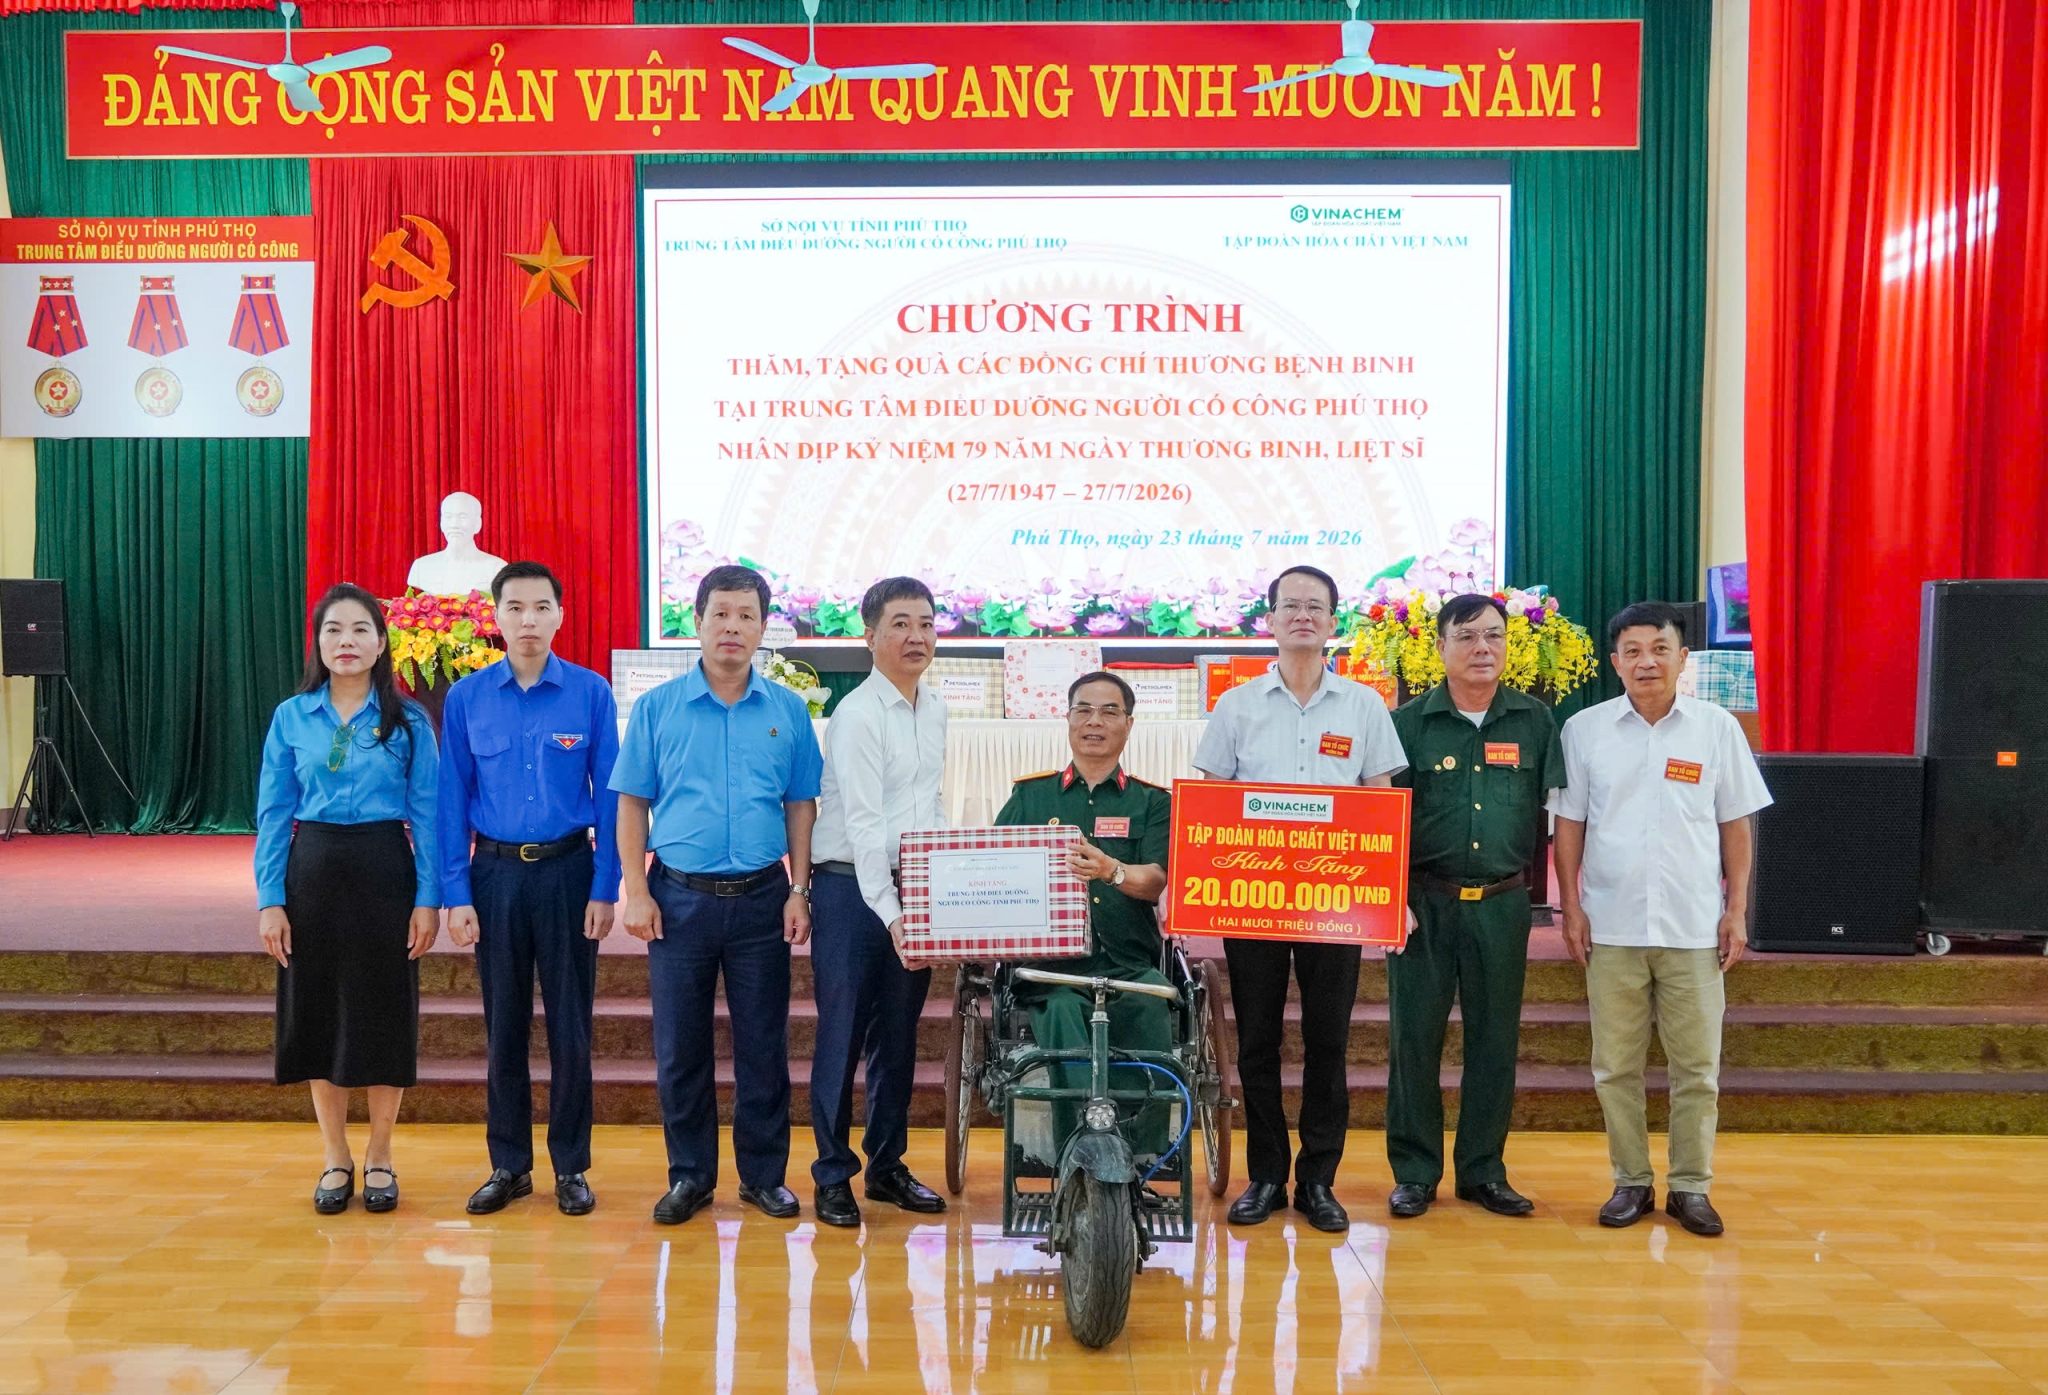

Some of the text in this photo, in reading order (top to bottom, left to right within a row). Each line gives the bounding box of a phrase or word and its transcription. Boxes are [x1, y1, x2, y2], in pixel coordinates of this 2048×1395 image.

[103, 47, 261, 126] ĐẢNG
[446, 43, 559, 124] SẢN
[575, 50, 706, 136] VIỆT
[869, 64, 1074, 125] QUANG
[1089, 65, 1237, 118] VINH
[1443, 48, 1576, 118] NĂM
[1312, 208, 1401, 219] VINACHEM
[58, 219, 257, 241] SỞ NỘI VỤ TỈNH PHÚ THỌ
[17, 241, 298, 260] TRUNG TÂM ĐIỀU DƯỠNG NGƯỜI CÓ CÔNG
[897, 295, 1244, 333] CHƯƠNG TRÌNH
[727, 351, 1414, 379] THĂM, TẶNG QUÀ CÁC ĐỒNG CHÍ THƯƠNG BỆNH BINH
[714, 393, 1428, 422] TẠI TRUNG TÂM ĐIỀU DƯỠNG NGƯỜI CÓ CÔNG PHÚ THỌ
[717, 437, 789, 459] NHÂN
[796, 442, 839, 463] DỊP
[889, 439, 956, 463] NIỆM
[963, 441, 987, 458] 79
[994, 437, 1053, 459] NĂM
[1060, 436, 1133, 458] NGÀY
[1139, 439, 1251, 458] THƯƠNG
[1260, 441, 1329, 461] BINH,
[1336, 438, 1395, 463] LIỆT
[1401, 437, 1424, 458] SĨ
[947, 483, 1057, 505] (27/7/1947
[1083, 483, 1192, 505] 27/7/2026)
[1011, 528, 1363, 550] Phú Thọ, ngày 23 tháng 7 năm 2026
[1264, 801, 1326, 812] VINACHEM
[1187, 822, 1393, 855] TẬP ĐOÀN HÓA CHẤT VIỆT NAM
[1212, 851, 1368, 881] Kính Tặng
[1184, 877, 1390, 913] 20.000.000 VNĐ
[1218, 917, 1353, 933] HAI MƯƠI TRIỆU ĐỒNG
